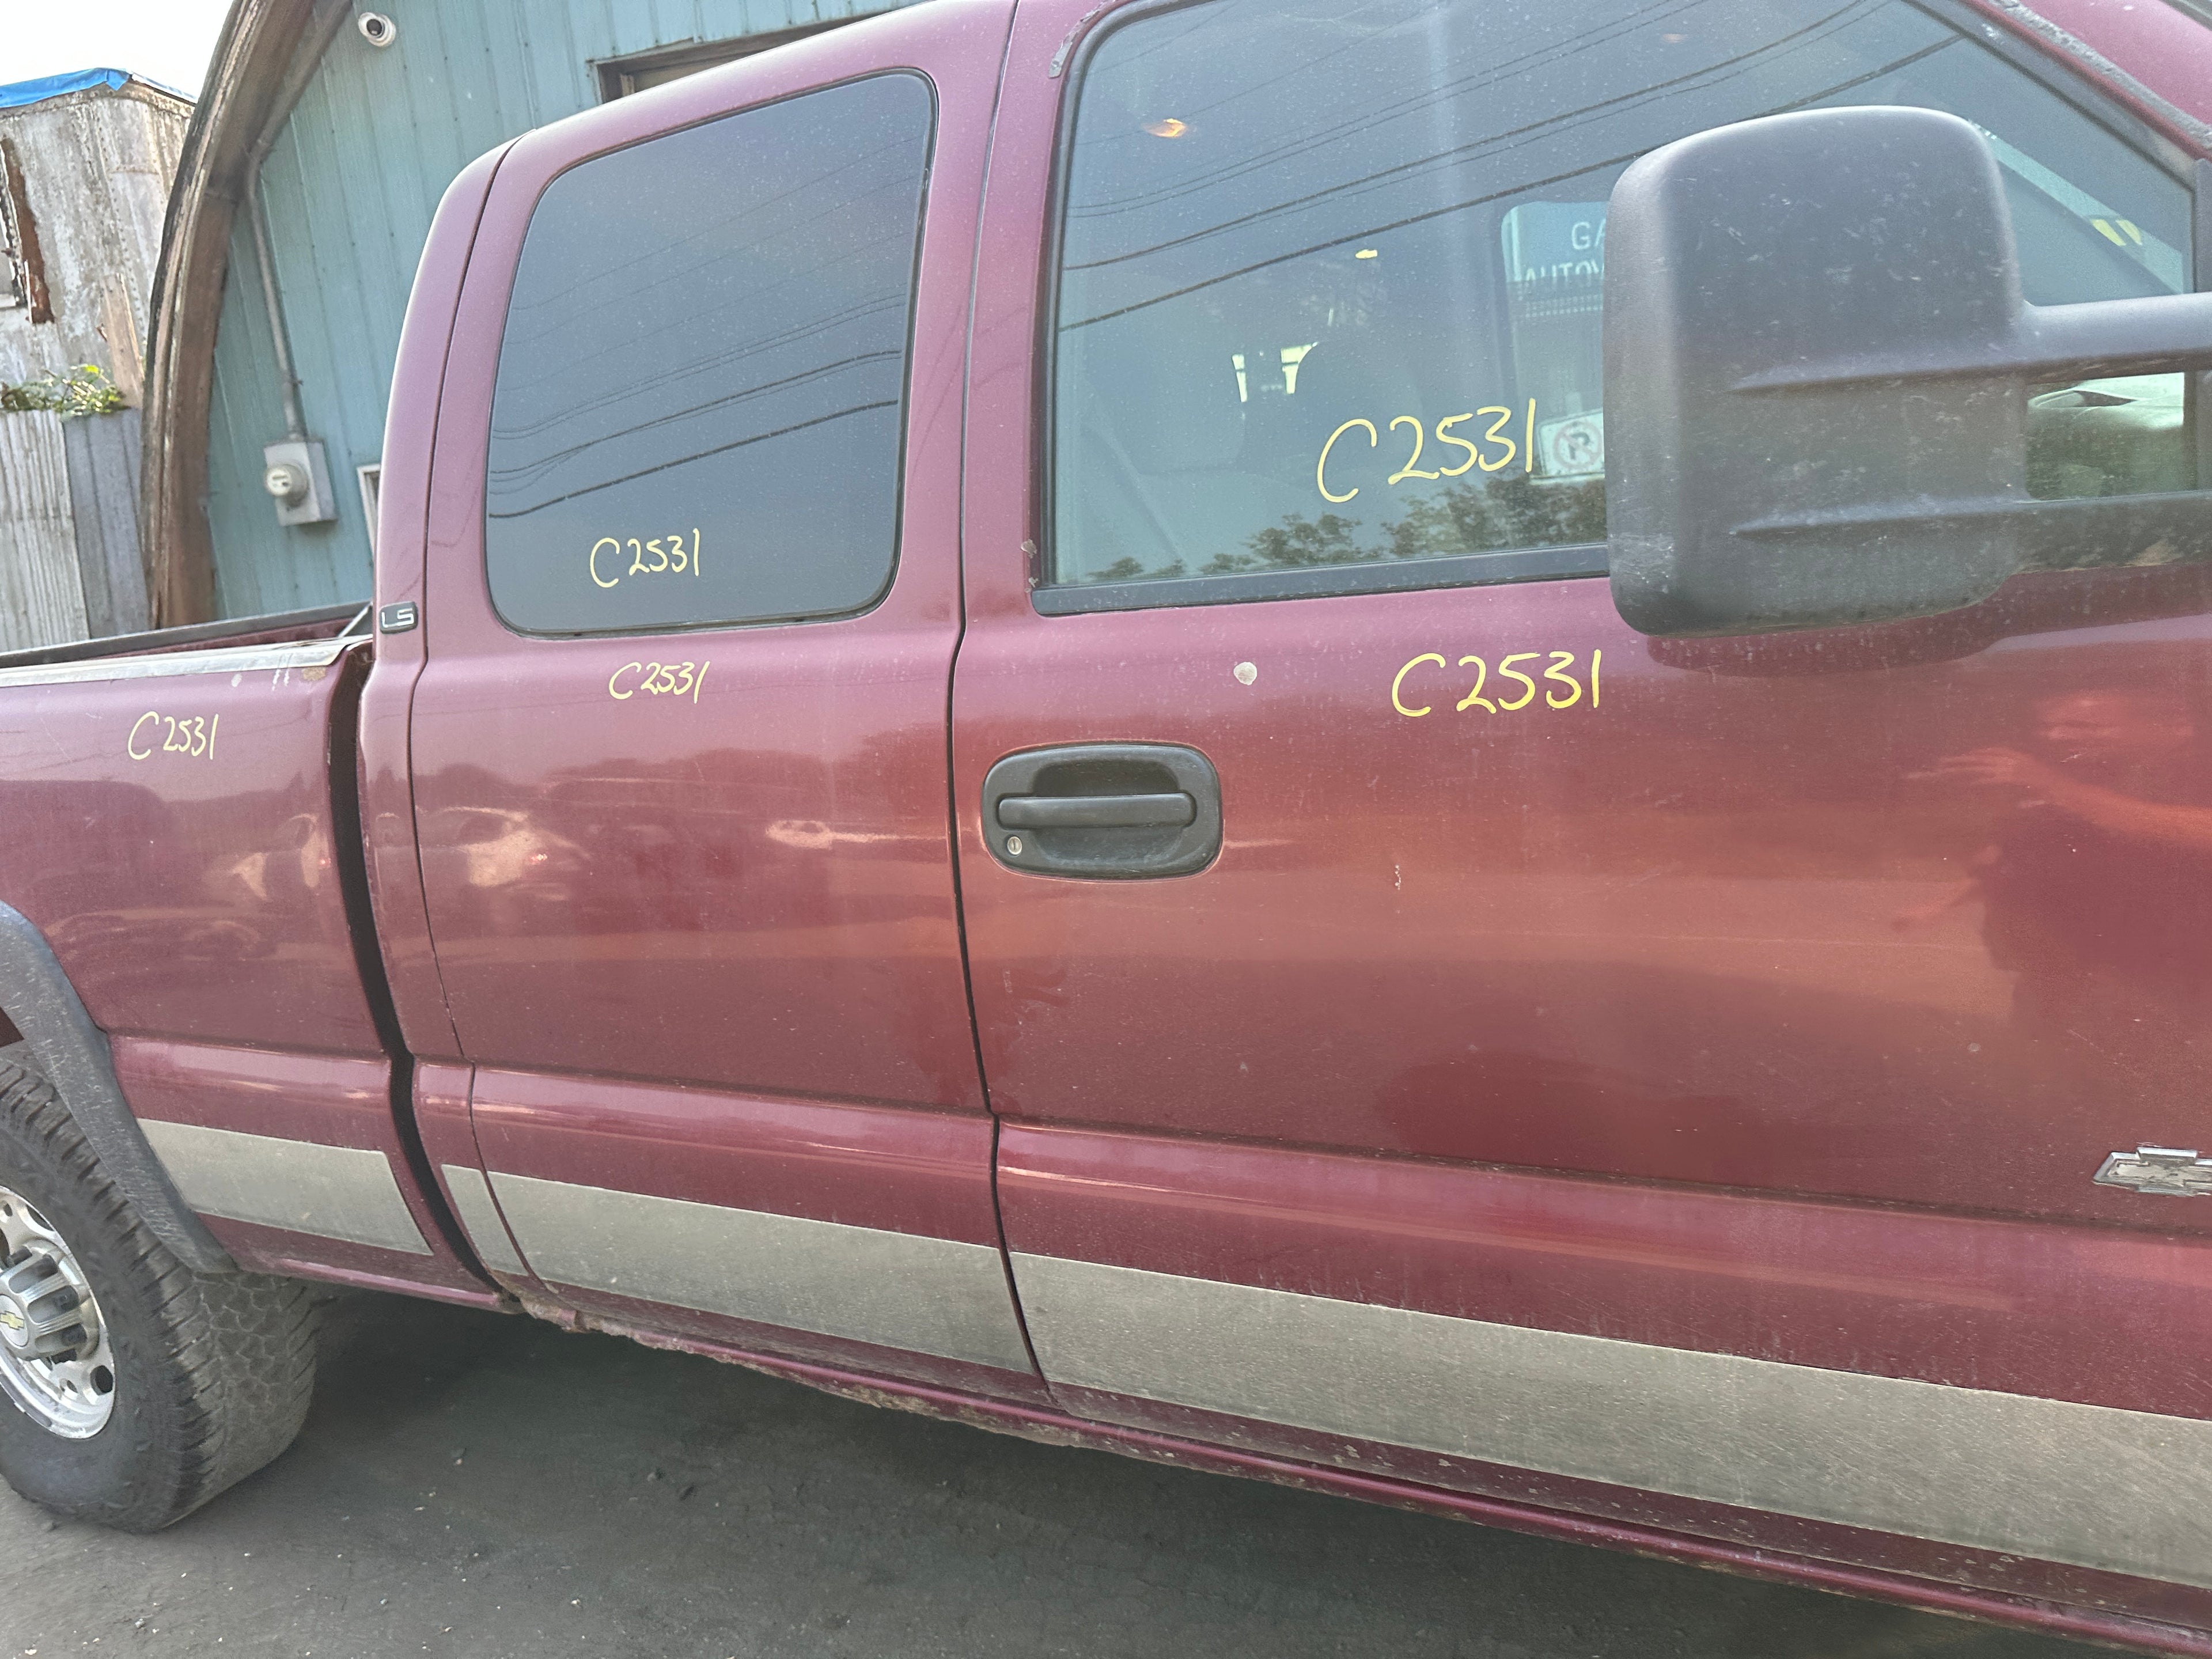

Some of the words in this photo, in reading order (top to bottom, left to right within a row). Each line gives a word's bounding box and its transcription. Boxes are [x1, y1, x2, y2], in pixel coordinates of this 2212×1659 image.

[589, 528, 700, 588] C2531
[381, 608, 414, 628] LS
[608, 661, 711, 704] C2531
[127, 711, 219, 760] C2531
